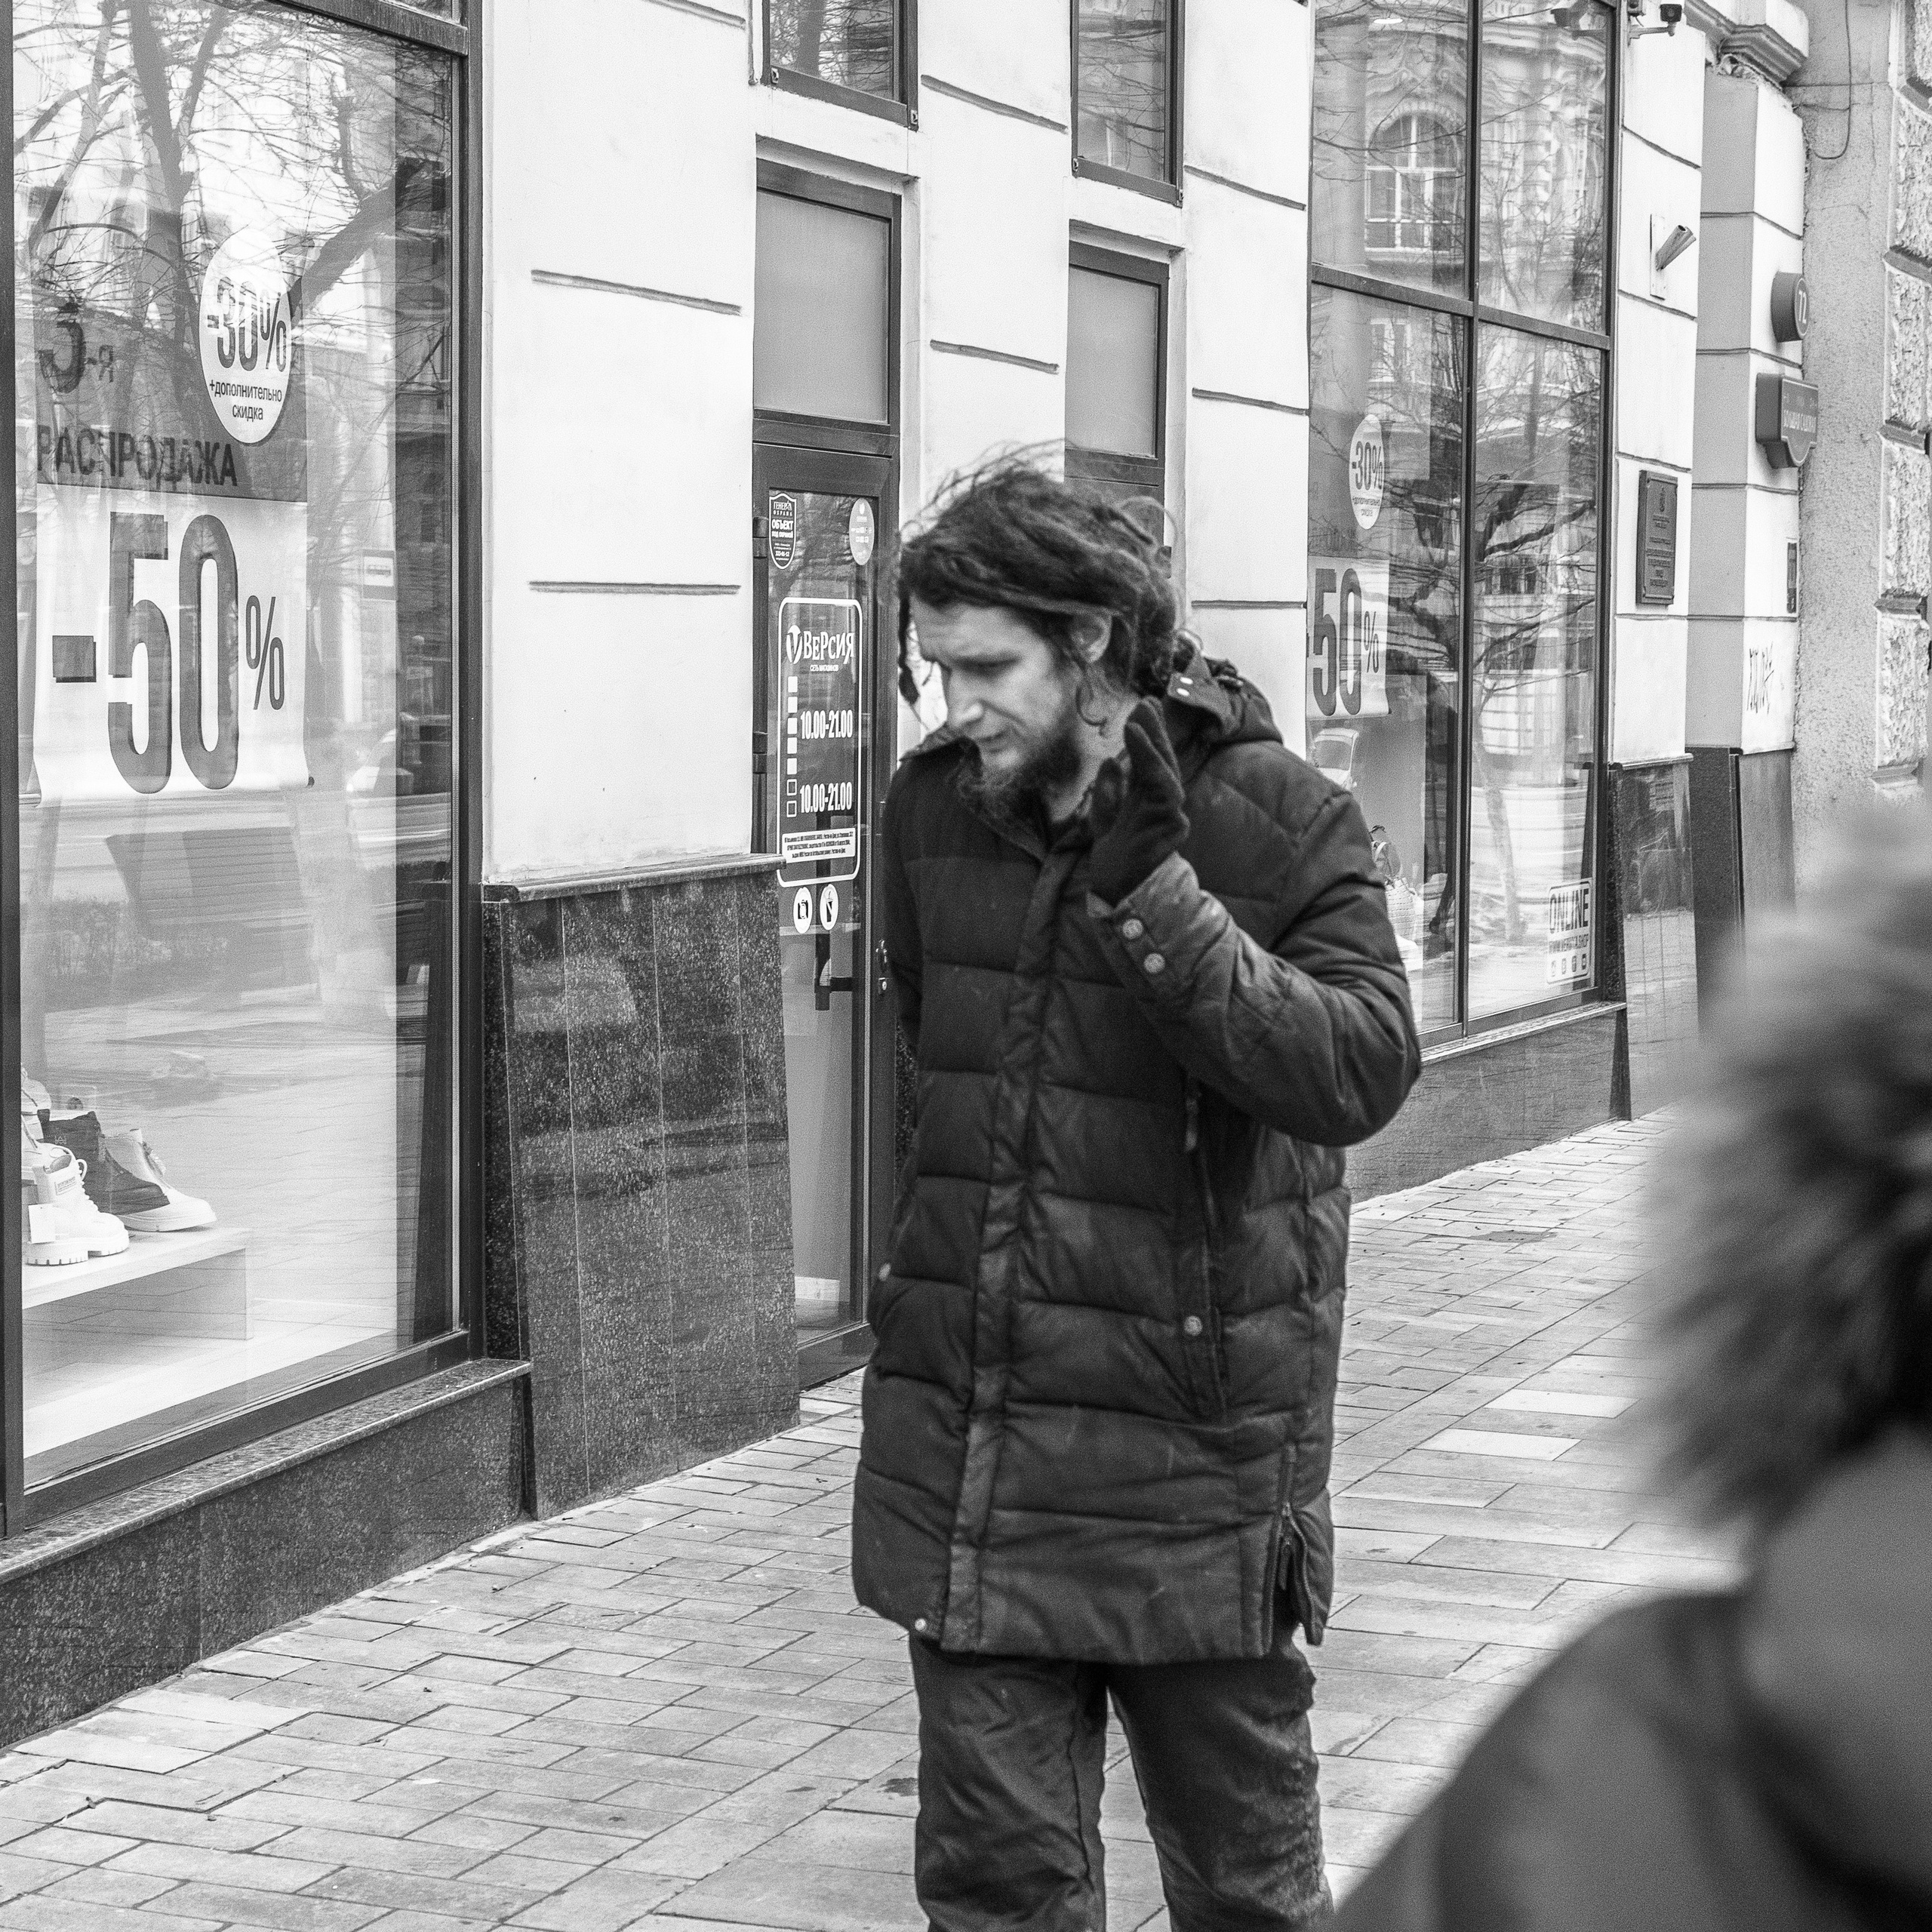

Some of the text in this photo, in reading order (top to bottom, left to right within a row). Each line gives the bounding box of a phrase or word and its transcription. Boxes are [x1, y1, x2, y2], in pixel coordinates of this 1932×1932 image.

[208, 277, 287, 372] -30%
[1798, 290, 1807, 325] 72
[209, 380, 282, 402] +дополнительно
[232, 404, 263, 422] скидка
[1352, 441, 1383, 491] -30%
[771, 518, 794, 531] ОБЪЕКТ
[52, 511, 285, 794] -50%
[803, 631, 855, 664] ВЕРСИЯ
[1306, 568, 1379, 716] 50%
[800, 709, 853, 739] 10.00-21.00
[800, 781, 853, 814] 10.00-21.00
[1549, 888, 1589, 934] ONLINE
